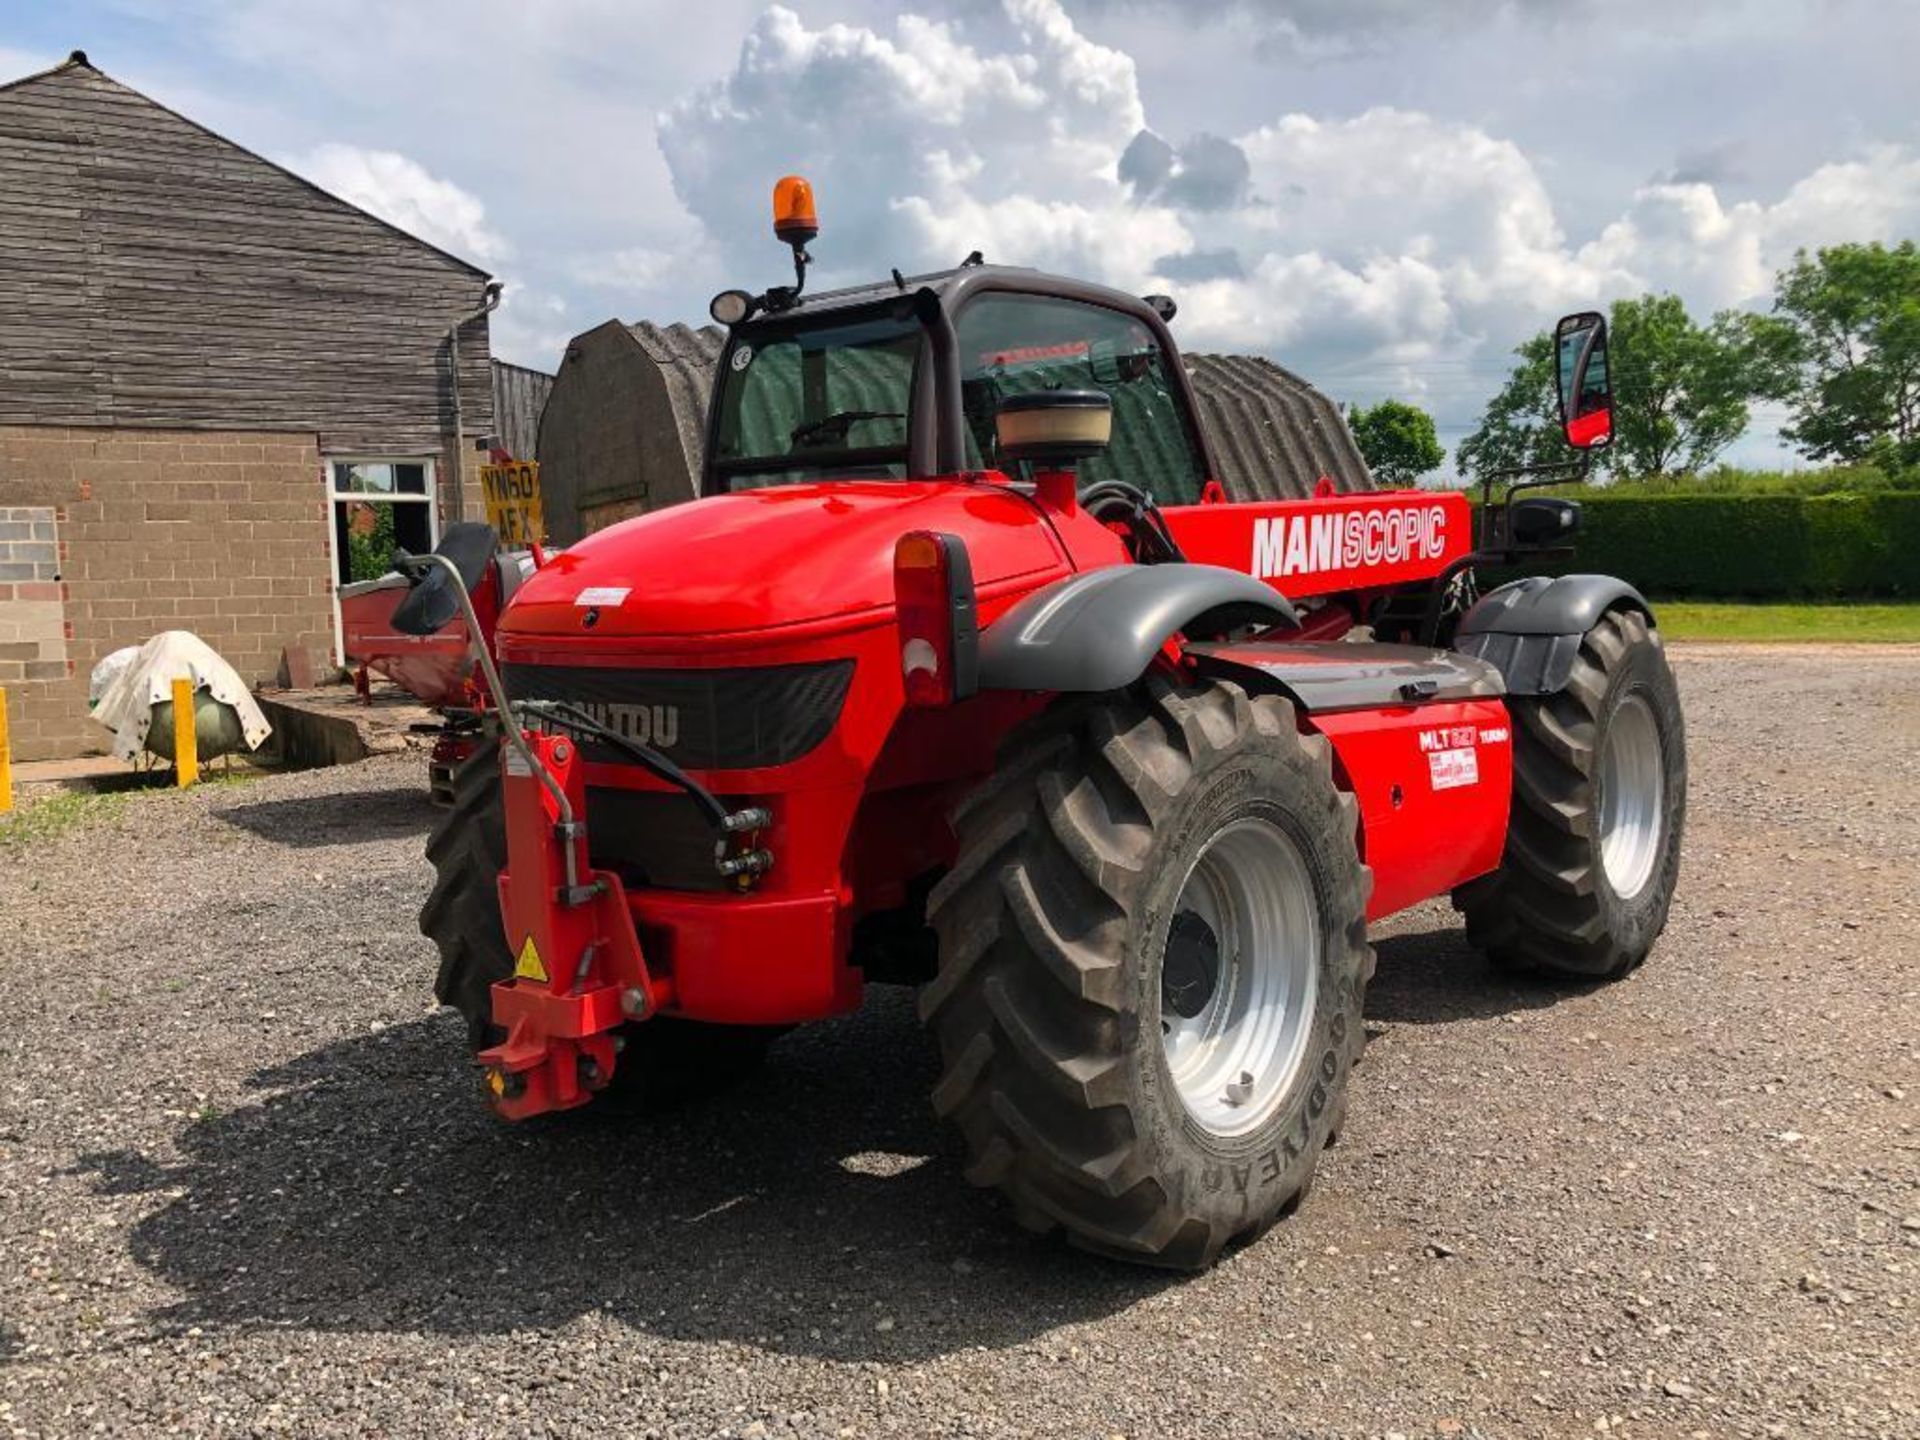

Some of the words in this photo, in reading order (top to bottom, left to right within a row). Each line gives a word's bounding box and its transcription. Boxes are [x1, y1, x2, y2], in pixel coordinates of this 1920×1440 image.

[498, 507, 533, 541] AFX
[1251, 505, 1445, 578] MANISCOPIC
[543, 702, 679, 748] ANITOU
[1419, 728, 1450, 752] MLT
